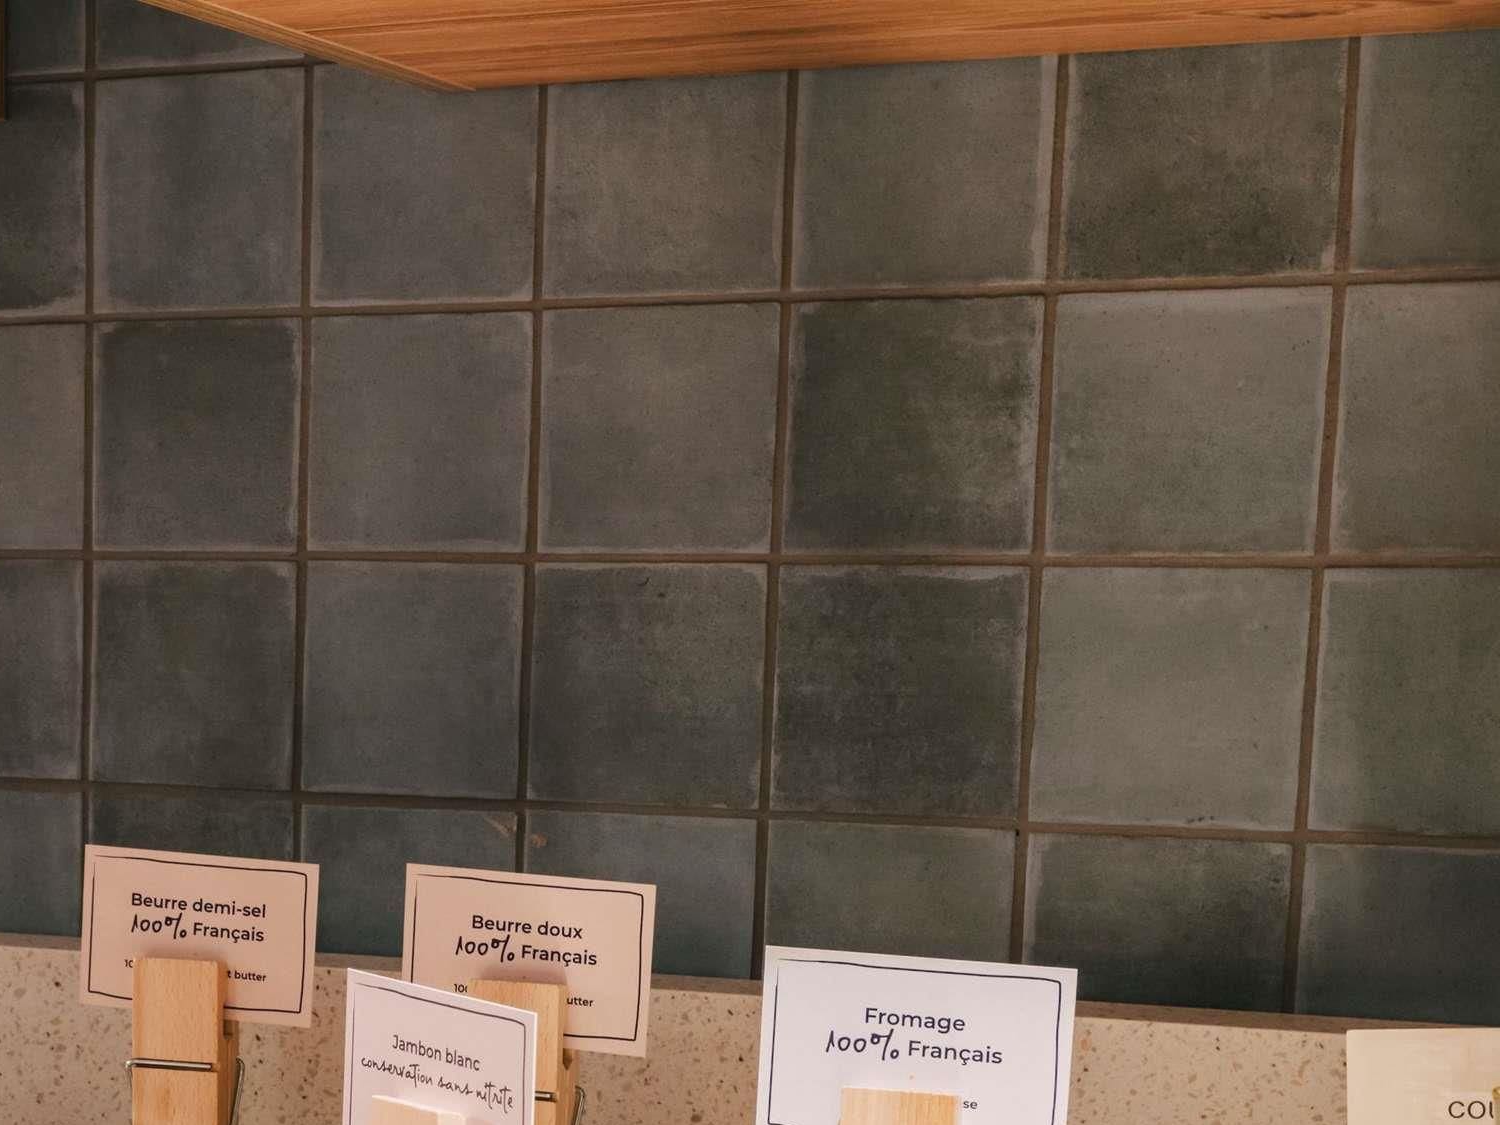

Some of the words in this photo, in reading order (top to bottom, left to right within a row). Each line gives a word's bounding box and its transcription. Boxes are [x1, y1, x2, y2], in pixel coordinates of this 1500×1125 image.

[131, 892, 188, 911] Beurre
[192, 898, 267, 919] demi-sel
[131, 912, 188, 940] 100%
[193, 921, 265, 944] Français
[471, 914, 532, 934] Beurre
[537, 920, 584, 940] doux
[455, 934, 516, 963] 100%
[521, 944, 598, 967] Français
[234, 969, 267, 983] butter
[566, 996, 594, 1008] utter
[864, 1007, 967, 1034] Fromage
[392, 1034, 443, 1062] Jambon
[445, 1047, 482, 1072] blanc
[825, 1028, 900, 1062] 100%
[907, 1040, 1004, 1066] Français
[361, 1056, 434, 1089] conservation
[437, 1075, 474, 1096] sans
[475, 1081, 515, 1114] nitrite
